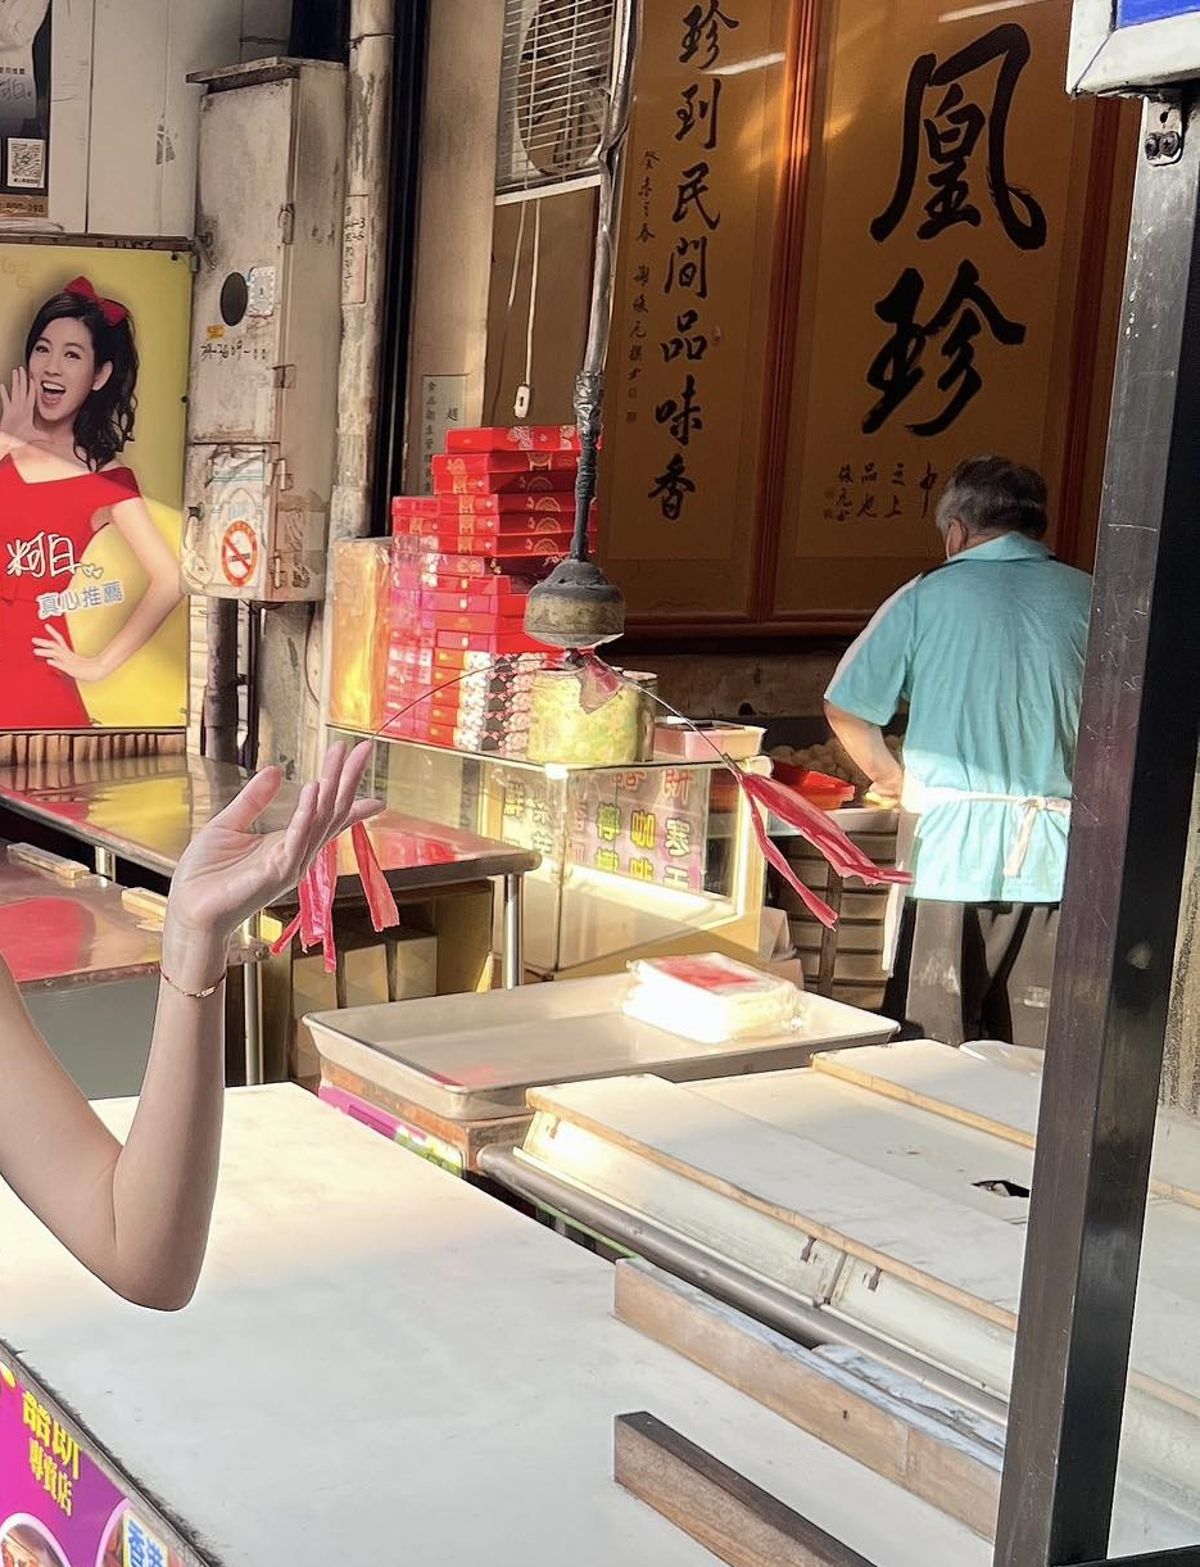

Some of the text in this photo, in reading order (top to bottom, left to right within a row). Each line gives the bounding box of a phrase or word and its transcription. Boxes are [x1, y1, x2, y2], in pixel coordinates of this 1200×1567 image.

[862, 22, 1047, 437] 凰珍
[38, 581, 124, 617] 真心推薦
